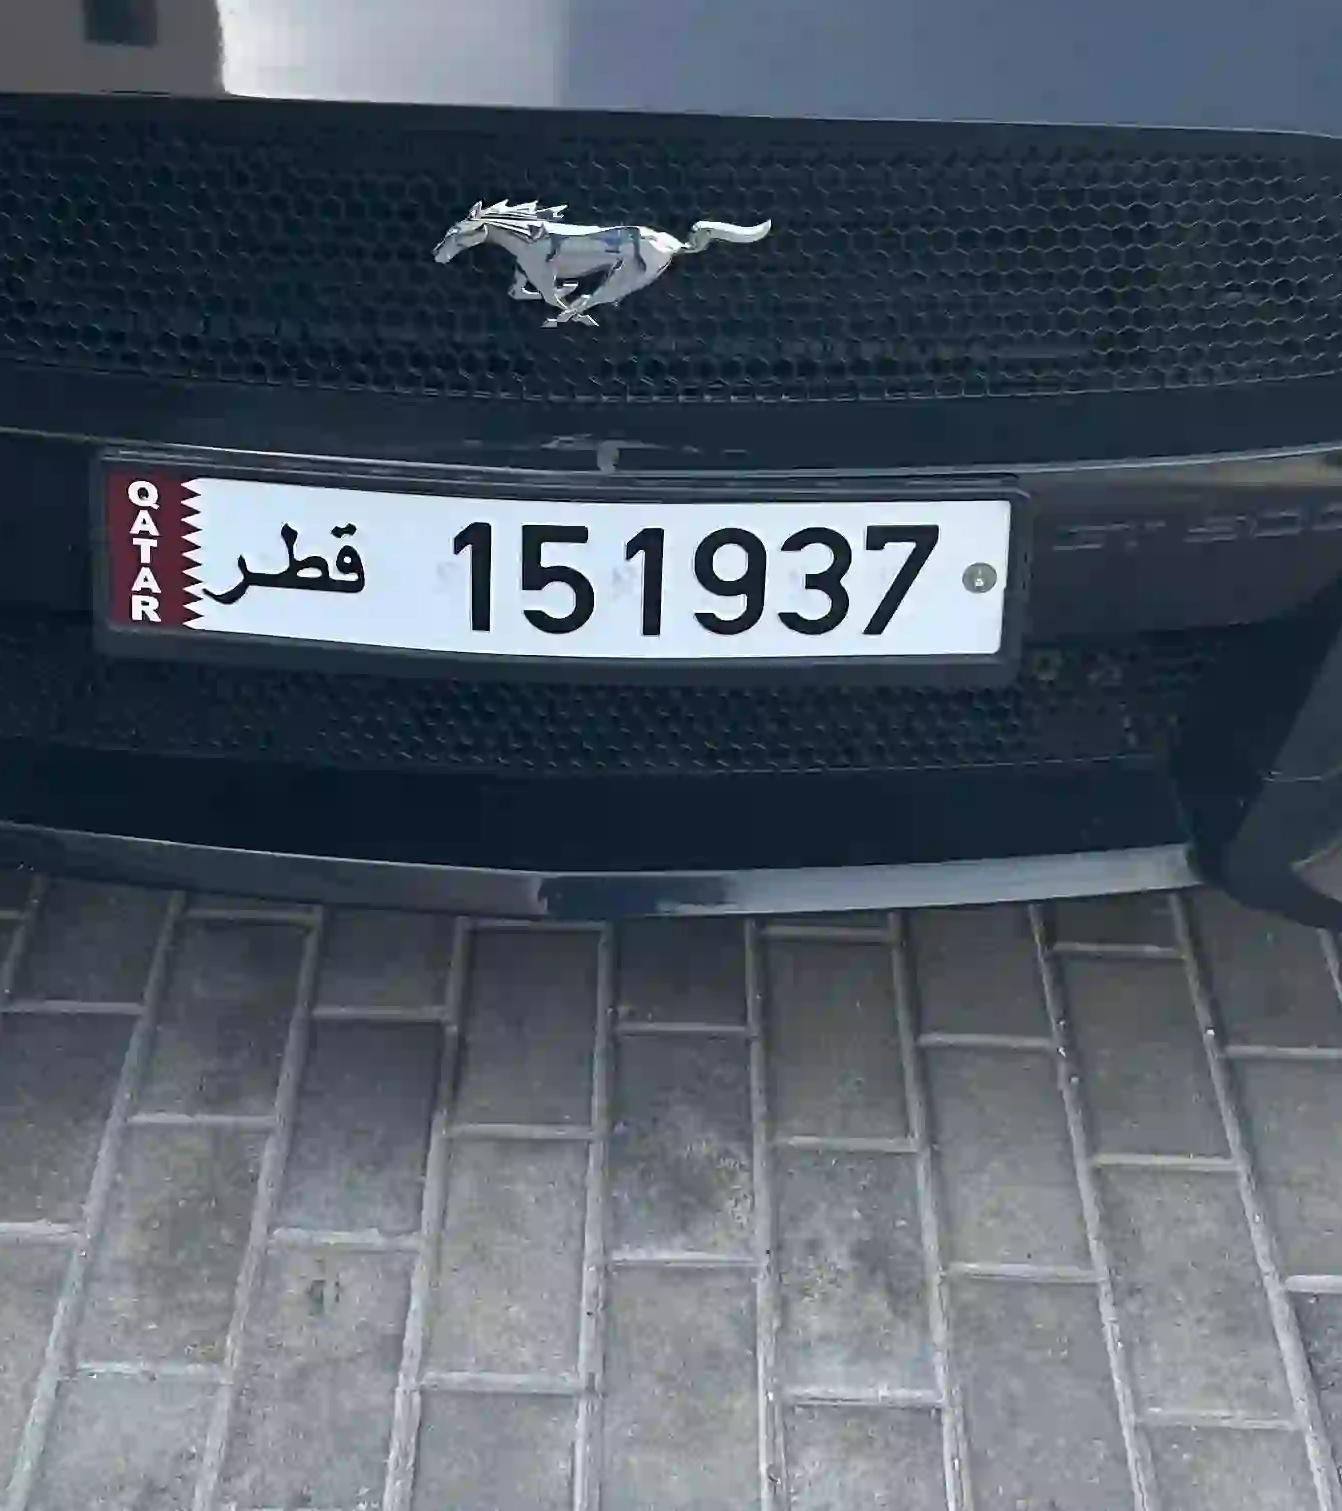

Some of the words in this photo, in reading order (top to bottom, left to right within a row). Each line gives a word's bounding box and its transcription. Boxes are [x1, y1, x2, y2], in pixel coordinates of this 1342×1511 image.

[127, 480, 161, 622] QATAR
[202, 522, 365, 605] قطر
[453, 522, 940, 636] 151937
